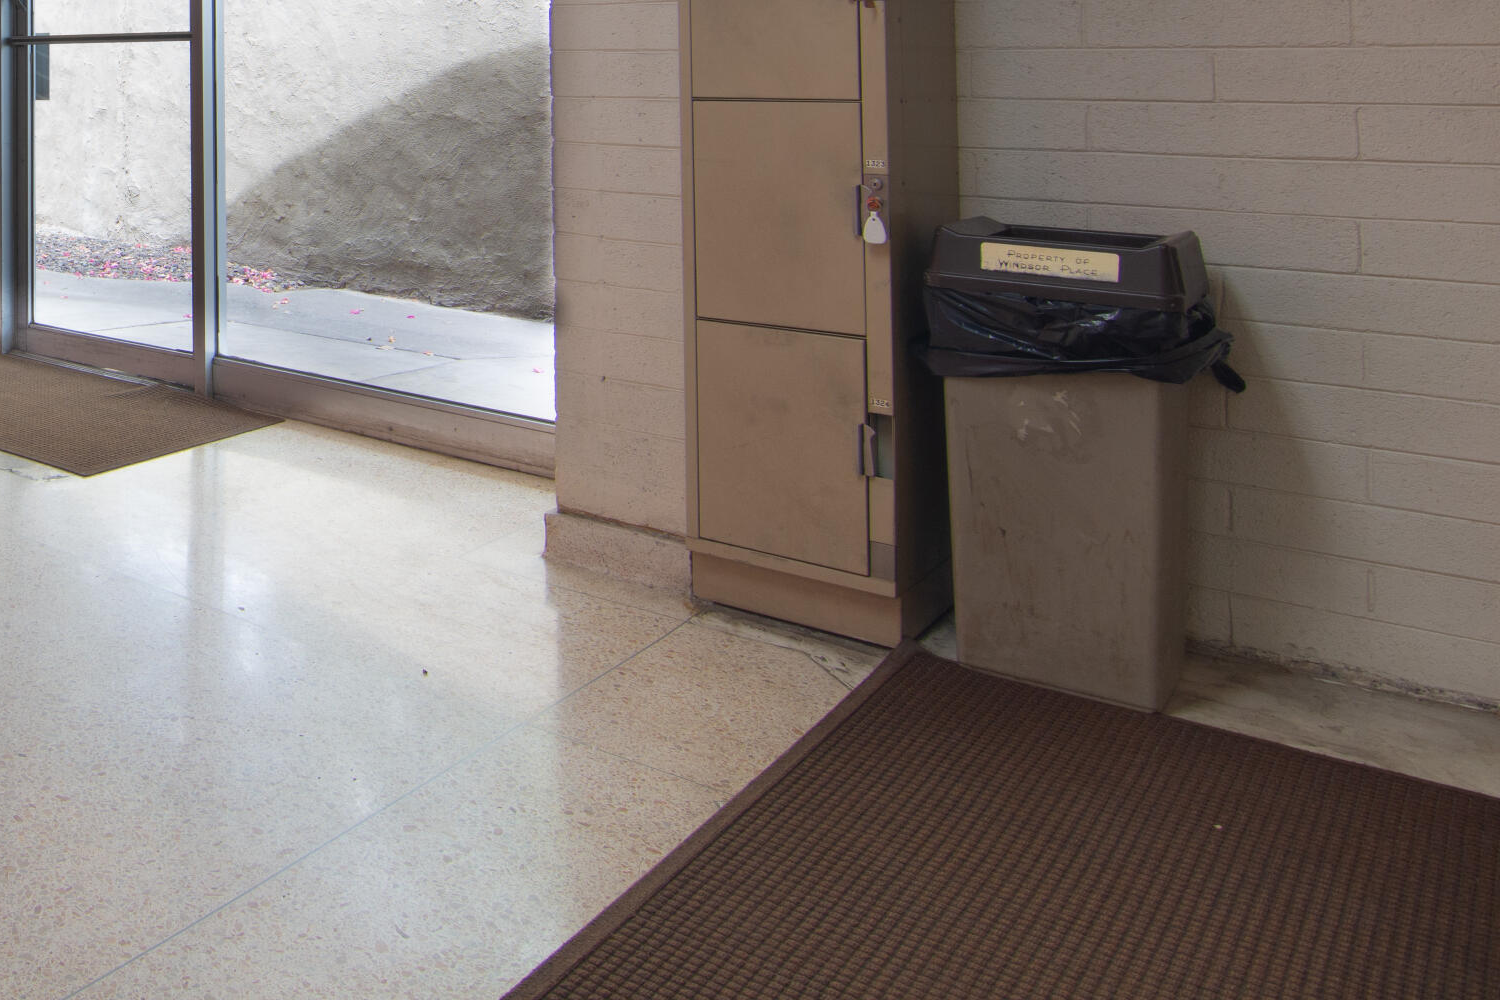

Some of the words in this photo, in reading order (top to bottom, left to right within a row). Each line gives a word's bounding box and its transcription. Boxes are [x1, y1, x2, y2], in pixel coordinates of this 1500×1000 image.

[1007, 249, 1065, 262] PROPERTY
[1075, 257, 1090, 265] OF
[998, 260, 1050, 271] WINDSOR
[1060, 264, 1098, 276] PLACE
